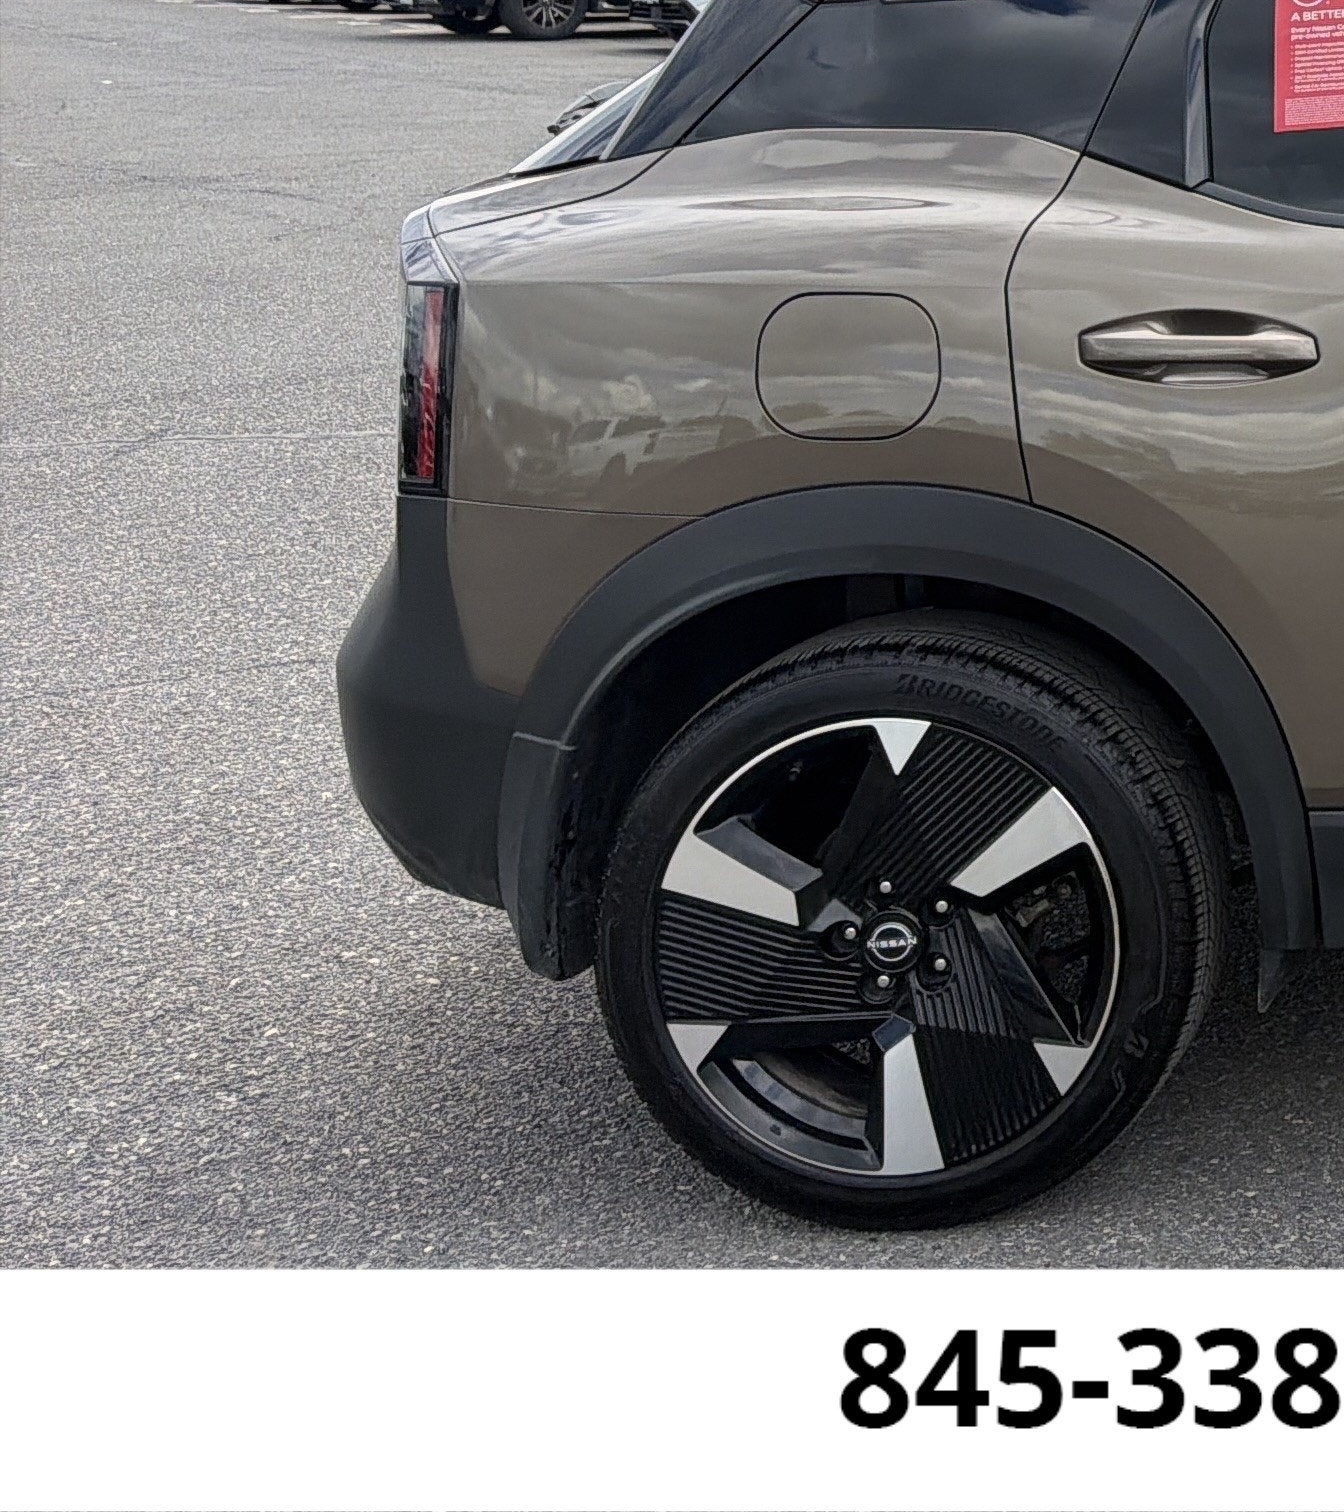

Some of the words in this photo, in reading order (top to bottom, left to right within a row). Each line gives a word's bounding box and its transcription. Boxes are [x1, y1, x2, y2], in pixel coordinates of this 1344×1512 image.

[1291, 12, 1301, 22] A
[897, 672, 1069, 752] BRIDGESTONE
[866, 936, 917, 949] NISSAN
